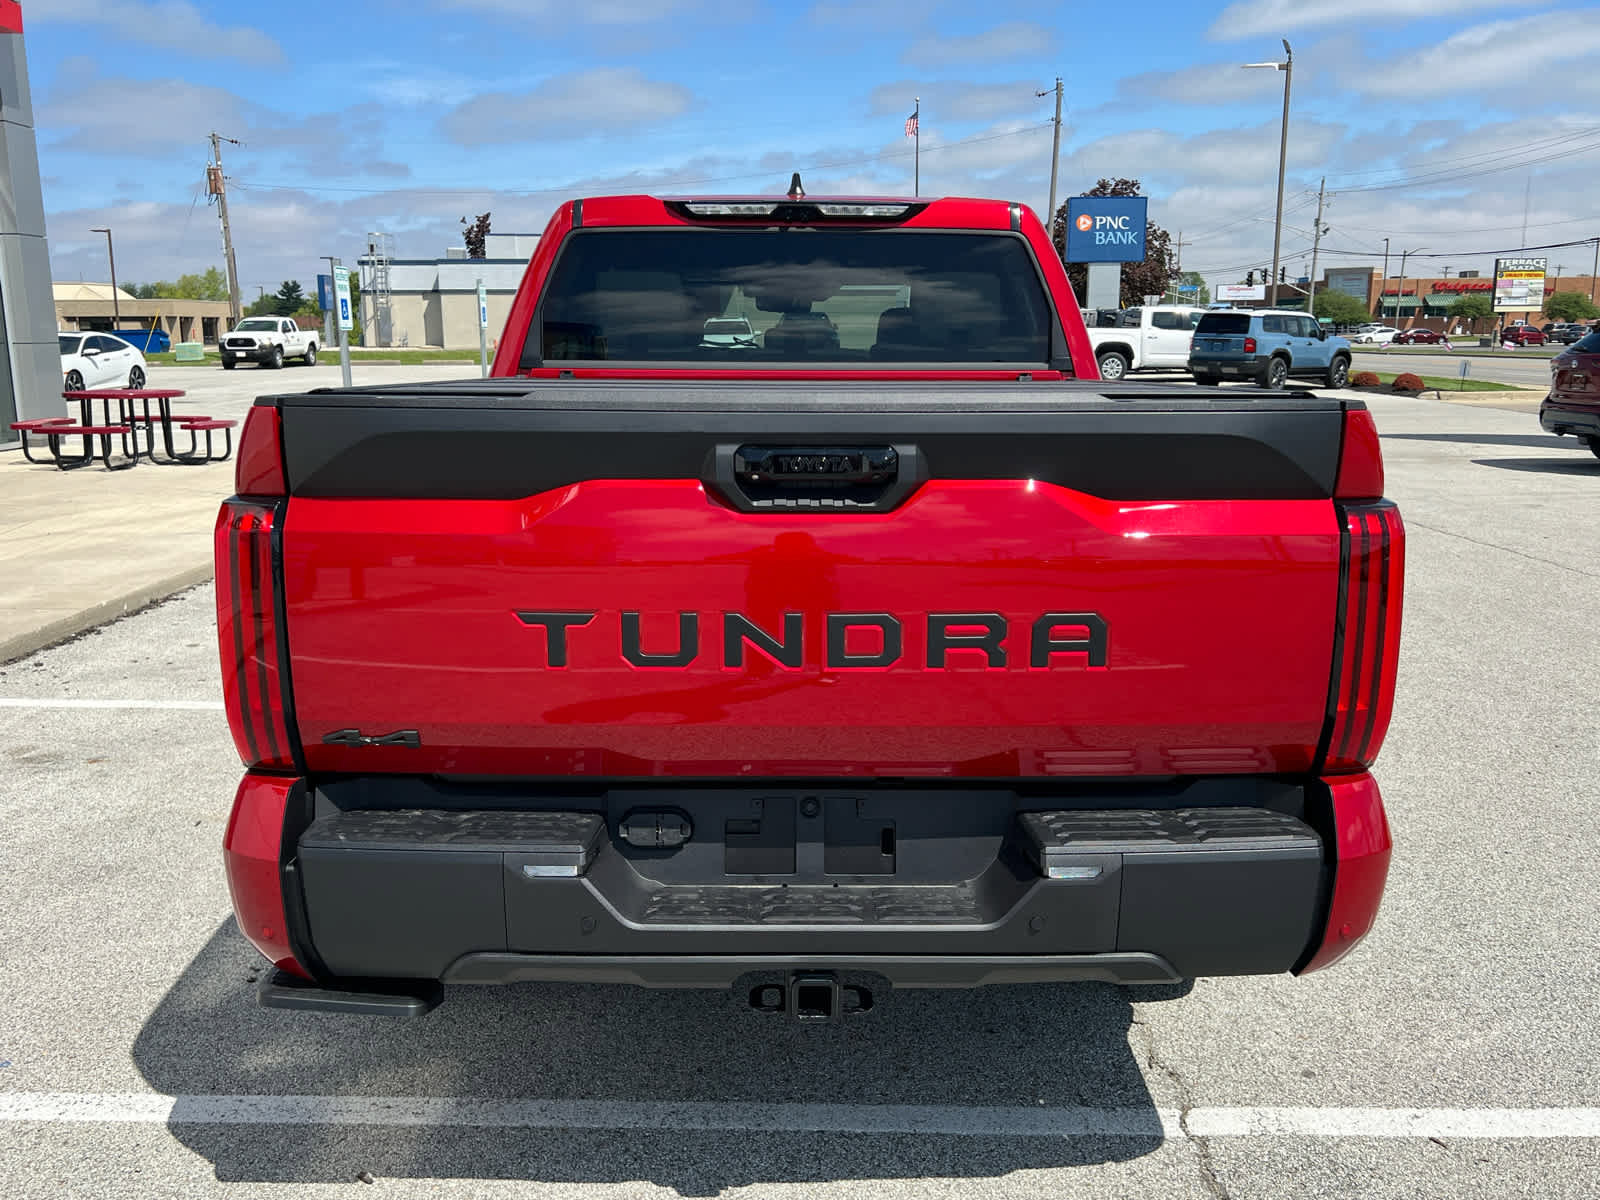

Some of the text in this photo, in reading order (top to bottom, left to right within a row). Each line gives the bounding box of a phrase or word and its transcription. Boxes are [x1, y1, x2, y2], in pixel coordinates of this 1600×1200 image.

[1095, 216, 1130, 230] PNC
[1094, 231, 1139, 245] BANK
[1498, 258, 1546, 269] TERRACE
[779, 456, 853, 473] TOYOTA
[512, 611, 1108, 669] TUNDRA
